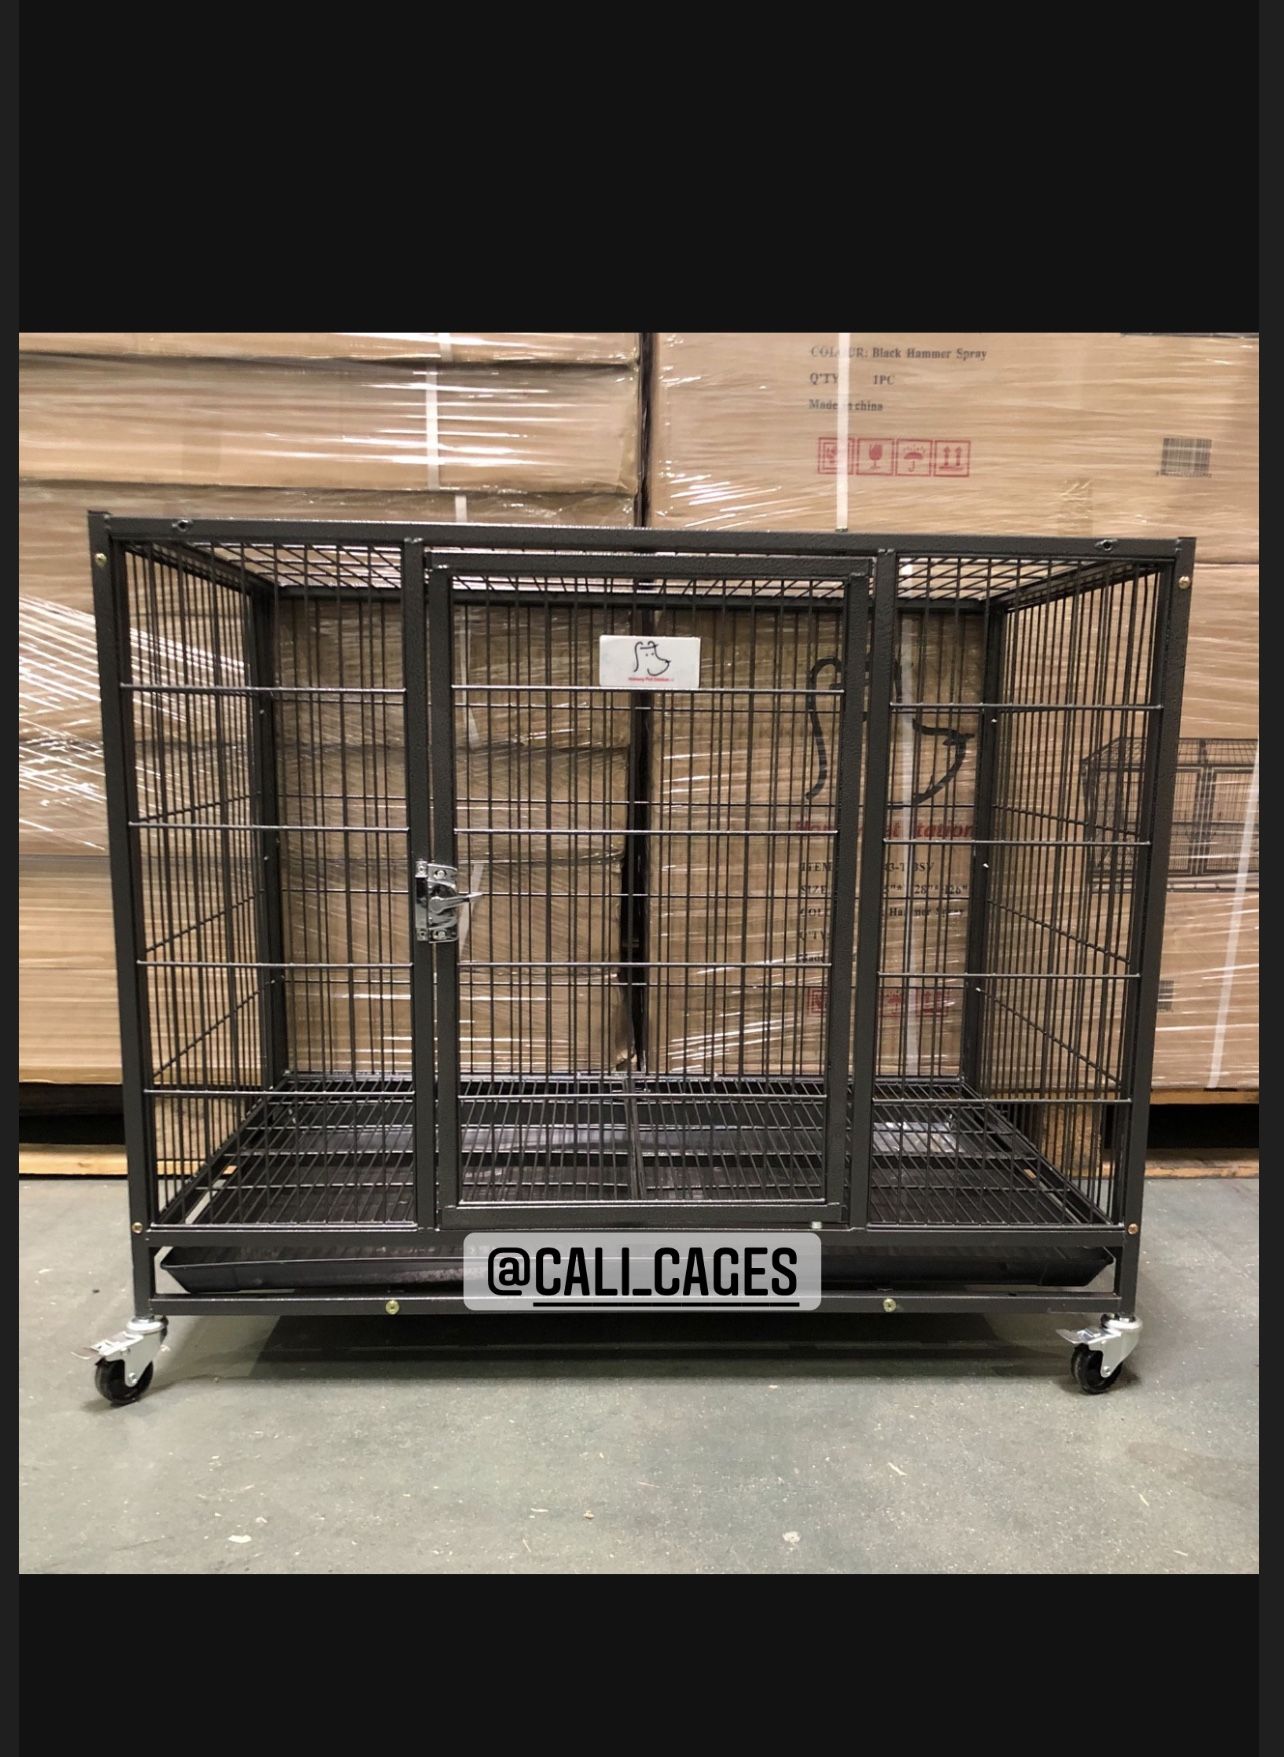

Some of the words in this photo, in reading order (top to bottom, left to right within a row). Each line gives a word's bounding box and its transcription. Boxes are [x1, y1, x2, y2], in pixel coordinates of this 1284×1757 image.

[811, 346, 868, 358] COLUR:
[872, 347, 901, 358] Black
[906, 348, 951, 359] Hammer
[956, 348, 987, 361] Spray
[872, 374, 896, 386] 1PC
[808, 399, 838, 410] Made
[855, 400, 884, 412] china
